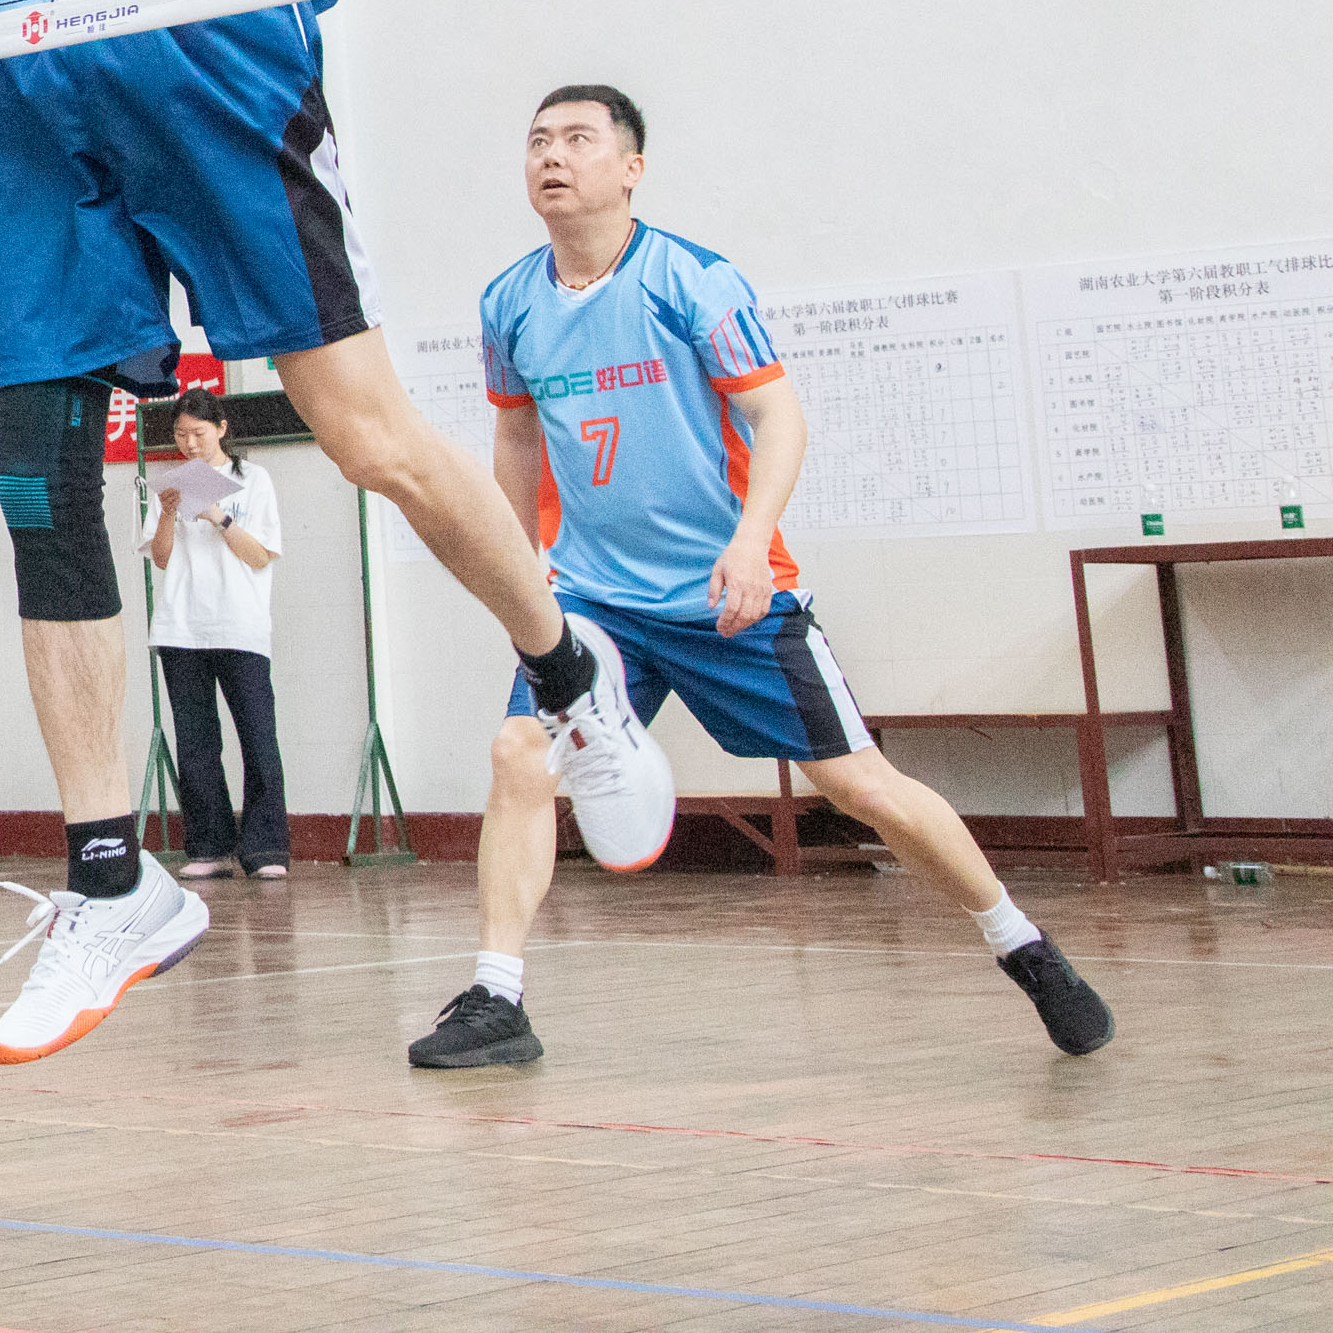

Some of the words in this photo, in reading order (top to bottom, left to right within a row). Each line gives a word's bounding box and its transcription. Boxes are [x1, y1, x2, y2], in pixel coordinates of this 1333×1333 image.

[56, 4, 140, 29] HENGJIA
[1158, 280, 1270, 304] 第一阶段积分表
[761, 289, 958, 321] 业大学第六届教职工气排球比赛
[793, 315, 889, 336] 第一阶段积分表
[596, 358, 667, 392] 好口语
[580, 415, 621, 487] 7
[81, 846, 127, 861] LI-NING
